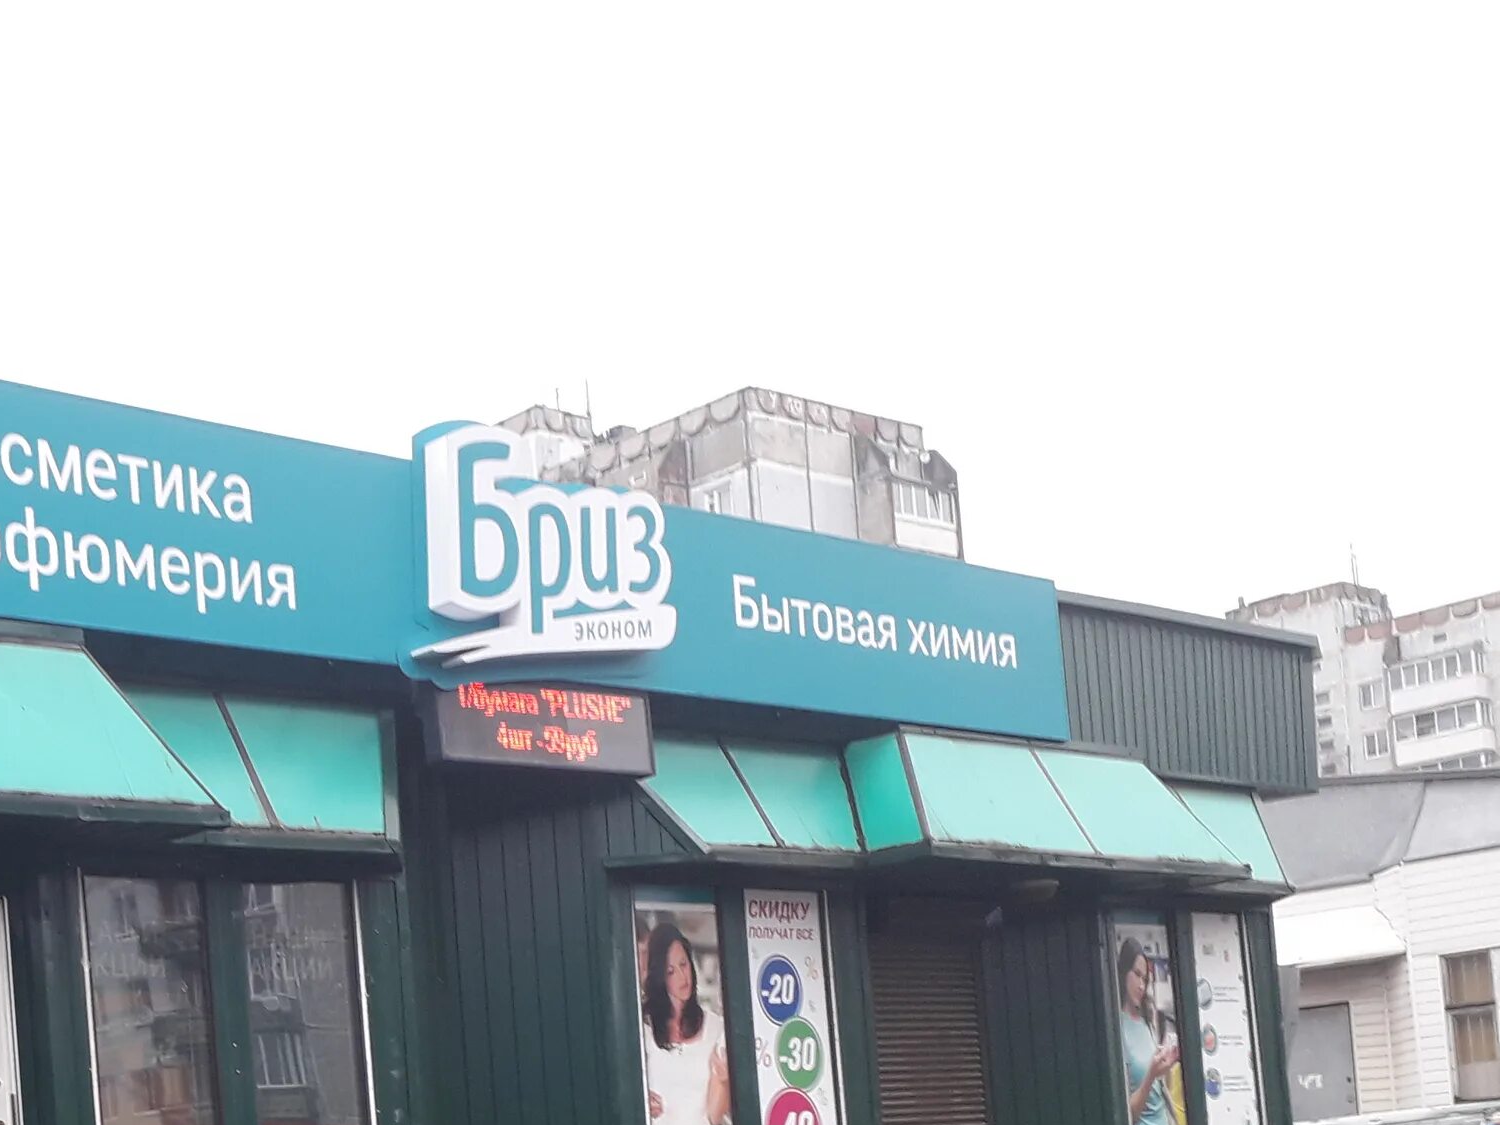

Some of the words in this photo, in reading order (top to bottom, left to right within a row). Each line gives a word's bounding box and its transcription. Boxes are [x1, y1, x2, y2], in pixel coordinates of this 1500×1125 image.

[457, 440, 662, 635] Бриз
[732, 573, 898, 652] Бытовая
[907, 618, 1018, 670] химия
[749, 900, 810, 923] СКИДКУ
[749, 926, 794, 940] ПОЛУЧАТ
[796, 928, 815, 941] ВСЕ
[761, 973, 796, 1005] -20
[779, 1036, 818, 1072] -30
